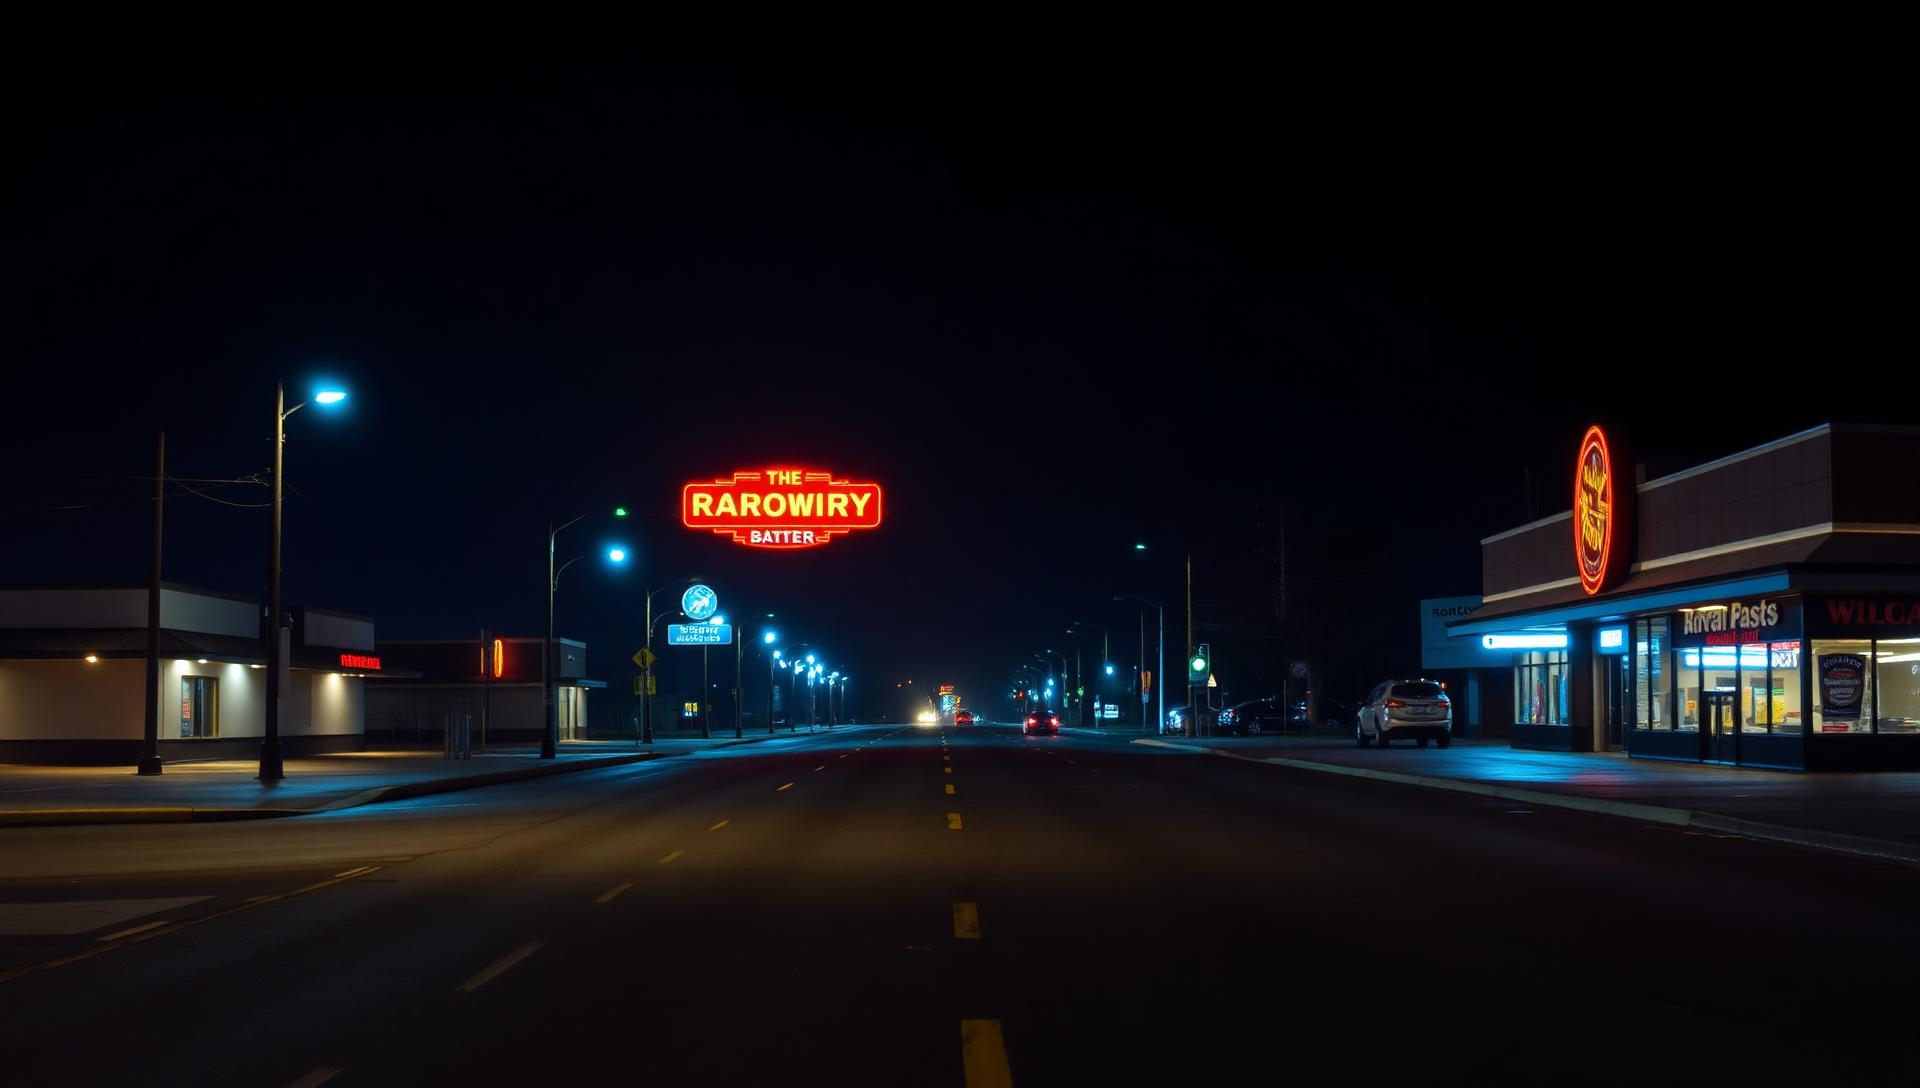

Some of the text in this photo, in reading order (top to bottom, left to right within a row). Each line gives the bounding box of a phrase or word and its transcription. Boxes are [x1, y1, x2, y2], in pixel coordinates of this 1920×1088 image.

[766, 471, 802, 485] THE
[692, 493, 872, 517] RAROWIRY
[750, 530, 815, 544] BATTER
